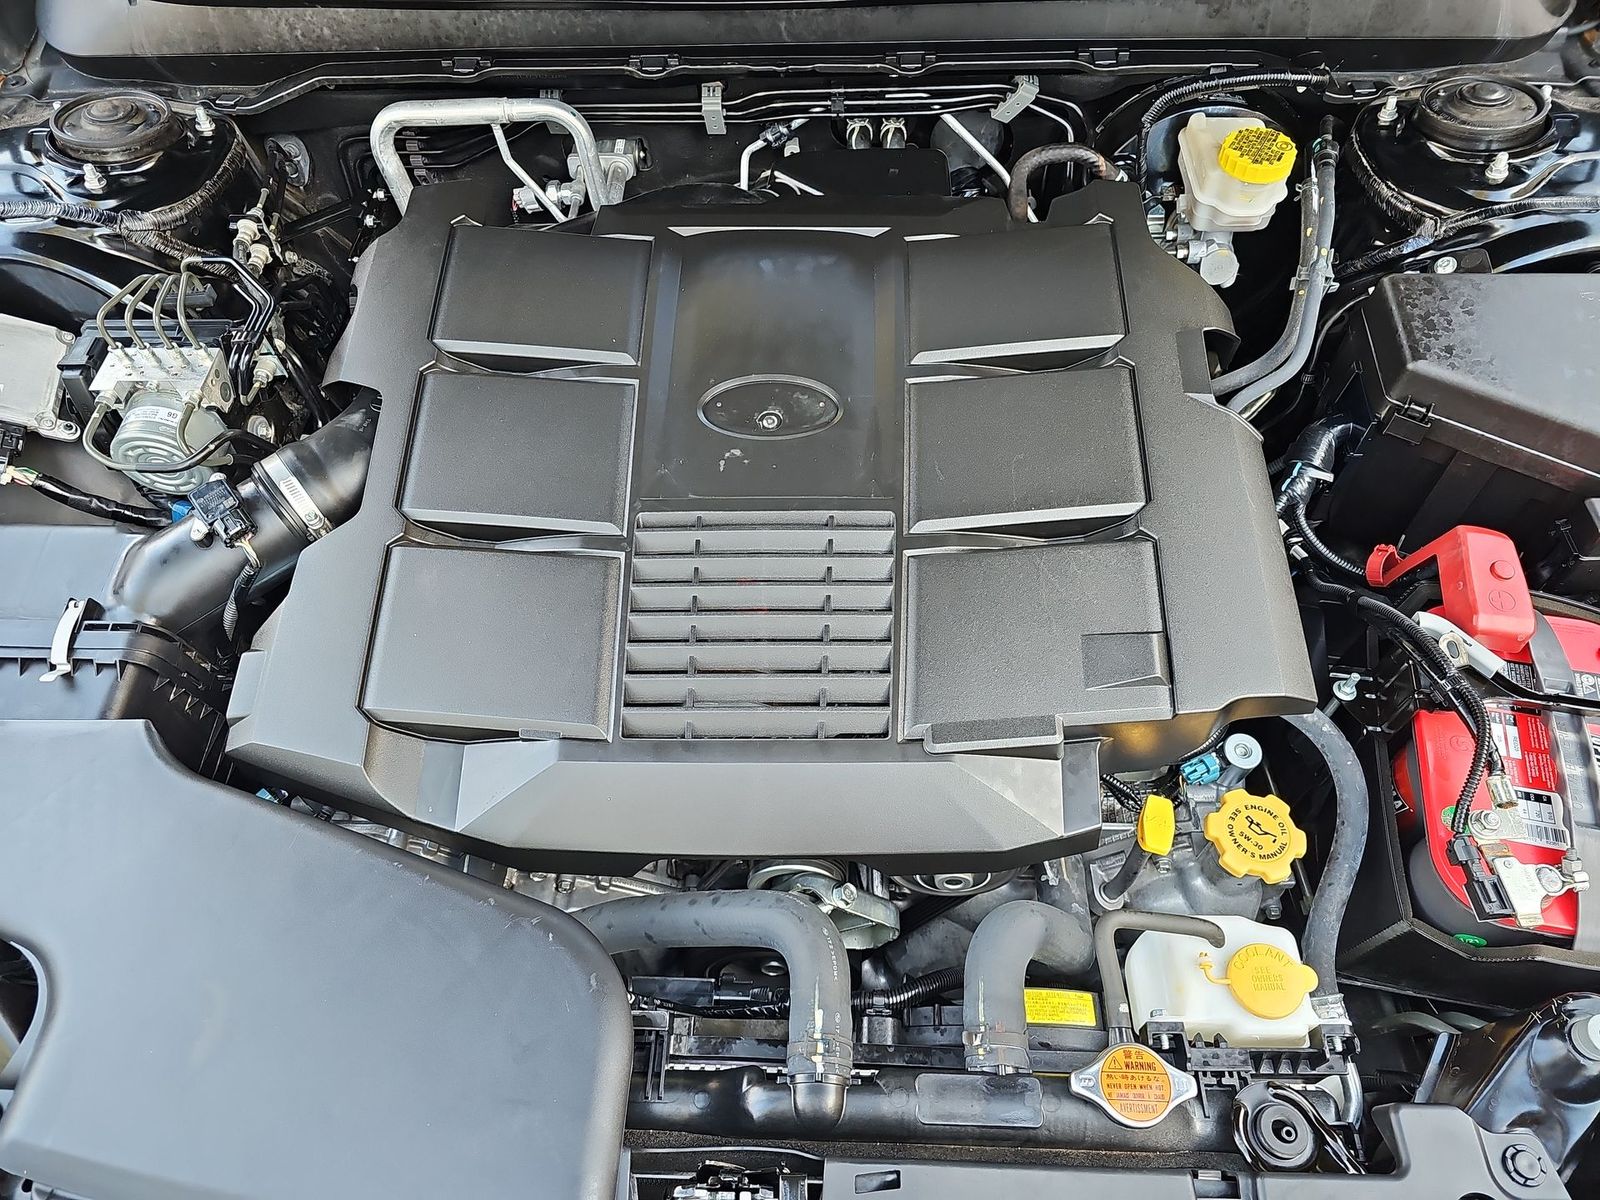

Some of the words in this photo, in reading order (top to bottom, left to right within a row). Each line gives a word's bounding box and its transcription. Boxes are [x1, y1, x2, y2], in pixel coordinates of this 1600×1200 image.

[1228, 808, 1242, 822] SEE
[1244, 804, 1279, 820] ENGINE
[1278, 822, 1288, 836] OIL
[1227, 824, 1256, 858] OWNER'S
[1258, 841, 1288, 860] MANUAL
[1238, 831, 1264, 850] 5W-30
[1234, 946, 1294, 970] COOLANT
[1254, 966, 1272, 974] SEE
[1251, 974, 1284, 983] OWNERS
[1252, 982, 1286, 991] MANUAL
[1122, 1050, 1144, 1060] 警告
[1124, 1060, 1157, 1072] WARNING
[1106, 1082, 1122, 1090] NEVER
